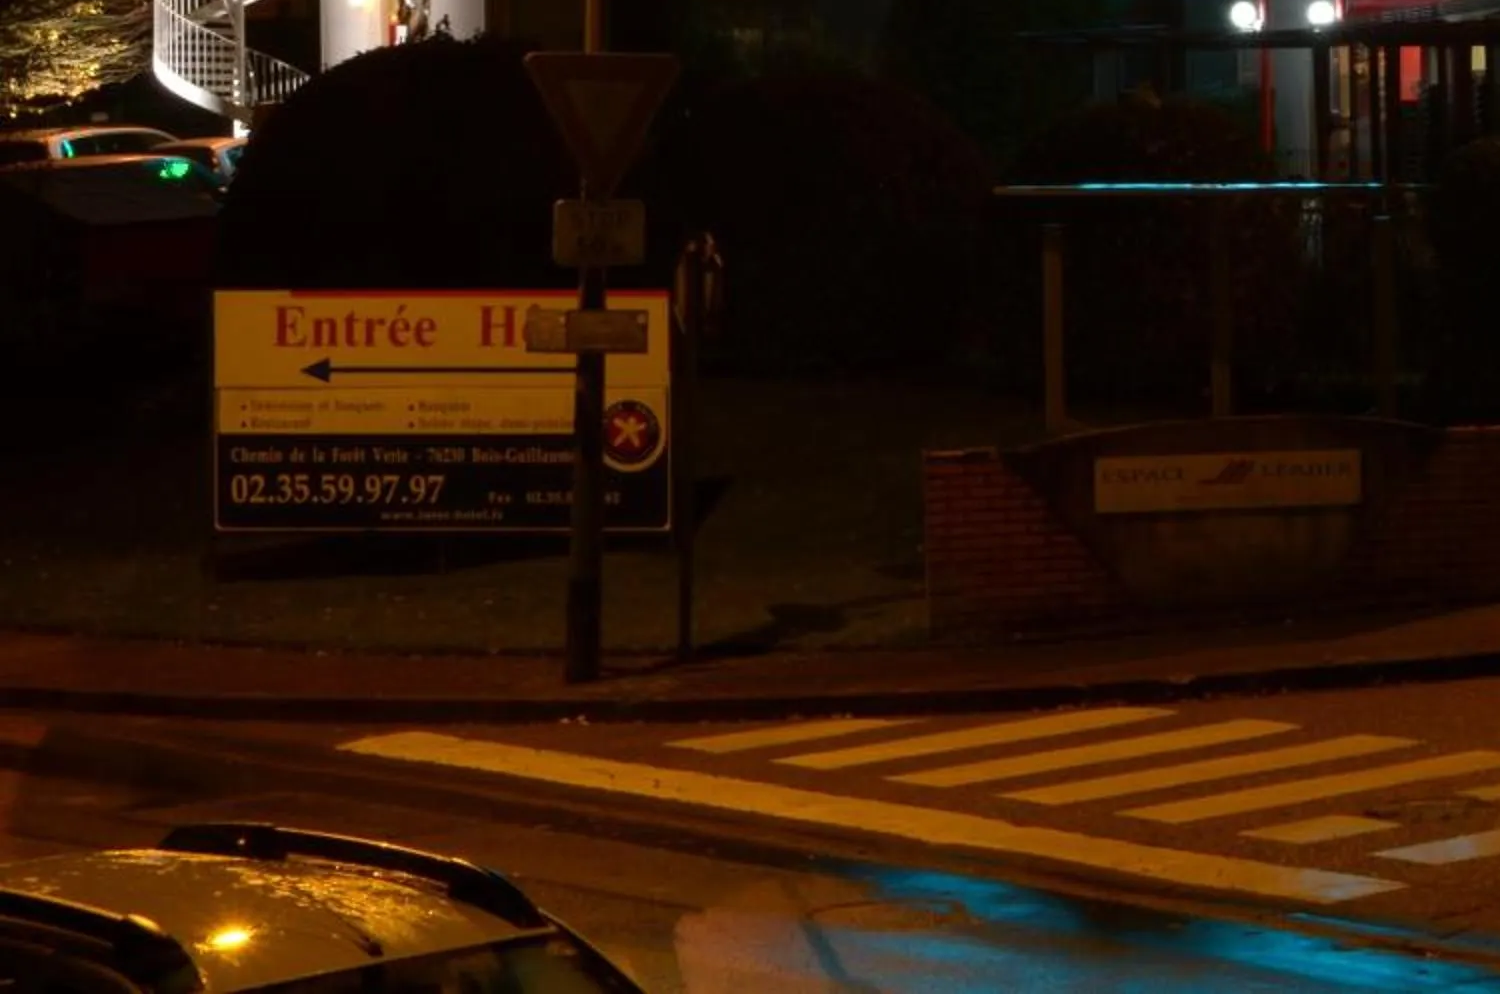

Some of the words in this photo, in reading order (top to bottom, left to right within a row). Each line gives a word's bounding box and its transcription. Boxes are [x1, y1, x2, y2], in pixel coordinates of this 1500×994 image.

[273, 303, 438, 349] Entrée
[230, 445, 284, 463] Chemin
[289, 445, 306, 463] de
[312, 444, 326, 463] la
[230, 472, 447, 505] 02.35.59.97.97
